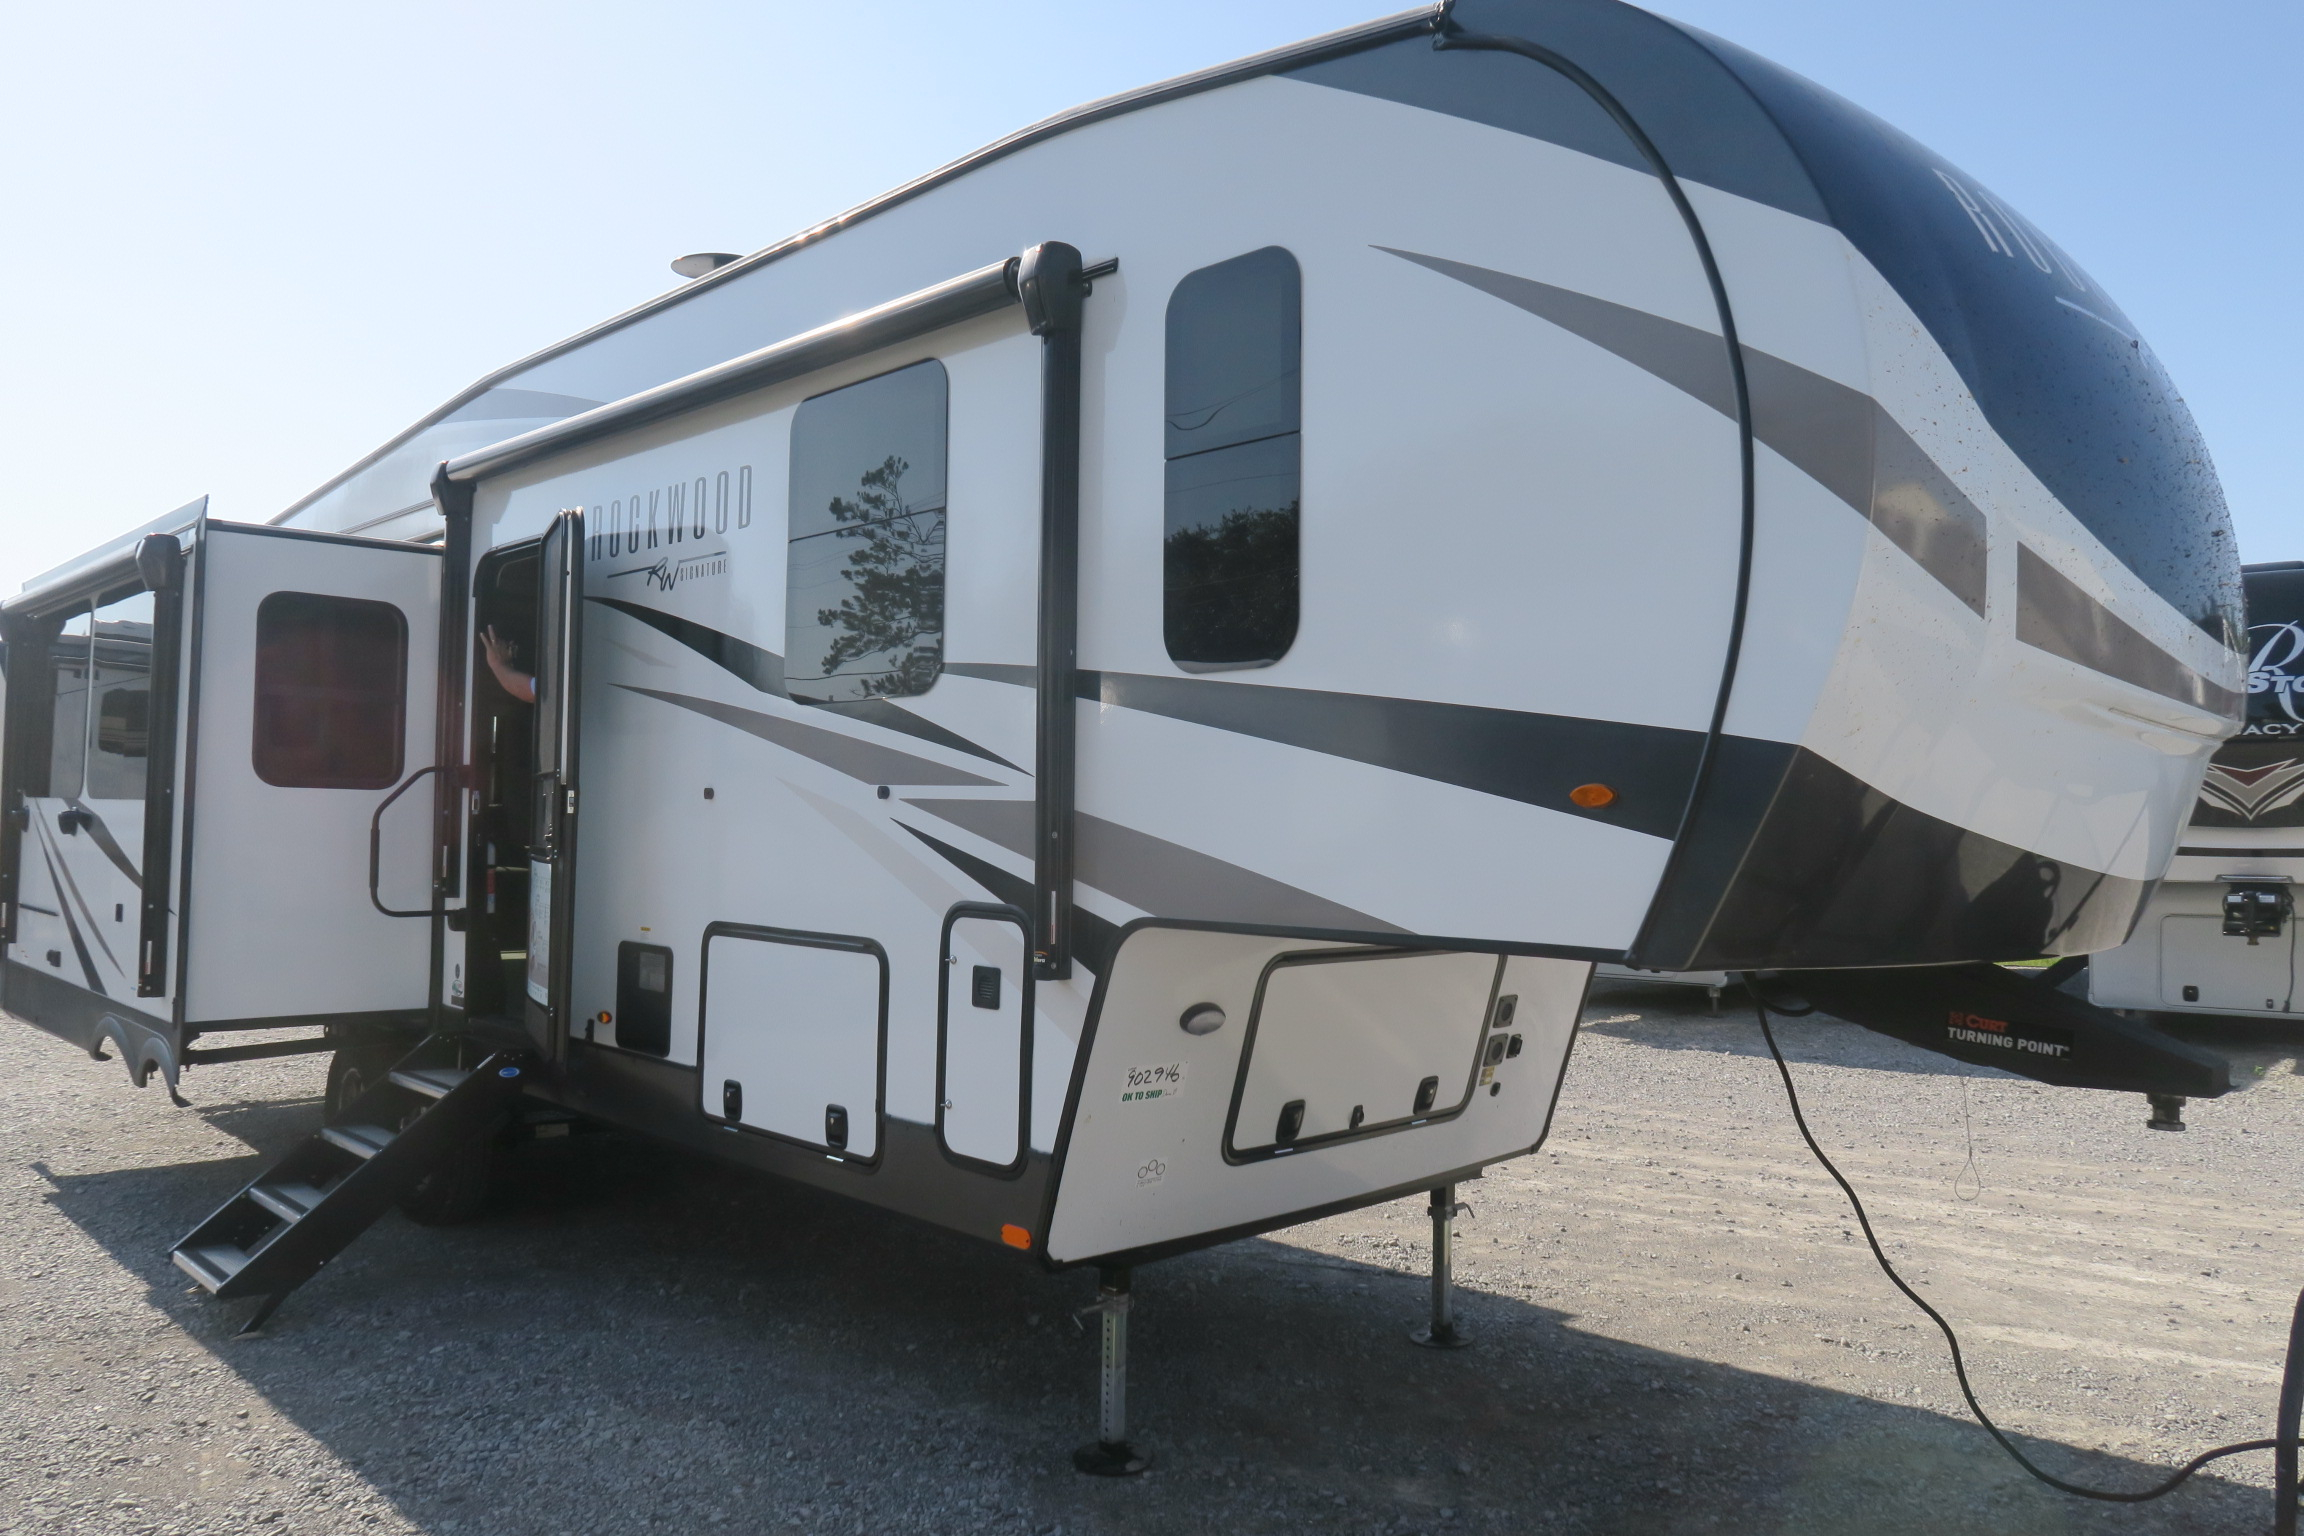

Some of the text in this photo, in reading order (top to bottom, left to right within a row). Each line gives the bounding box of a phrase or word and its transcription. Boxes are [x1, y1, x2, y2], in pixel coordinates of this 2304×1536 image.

[591, 464, 753, 561] ROCKWOOD
[681, 559, 727, 581] SIGNATURE
[2238, 723, 2303, 735] ACY
[1948, 1026, 2014, 1048] TURNING
[1122, 1092, 1134, 1102] OK
[1135, 1091, 1145, 1101] TO
[1145, 1089, 1163, 1099] SHIP
